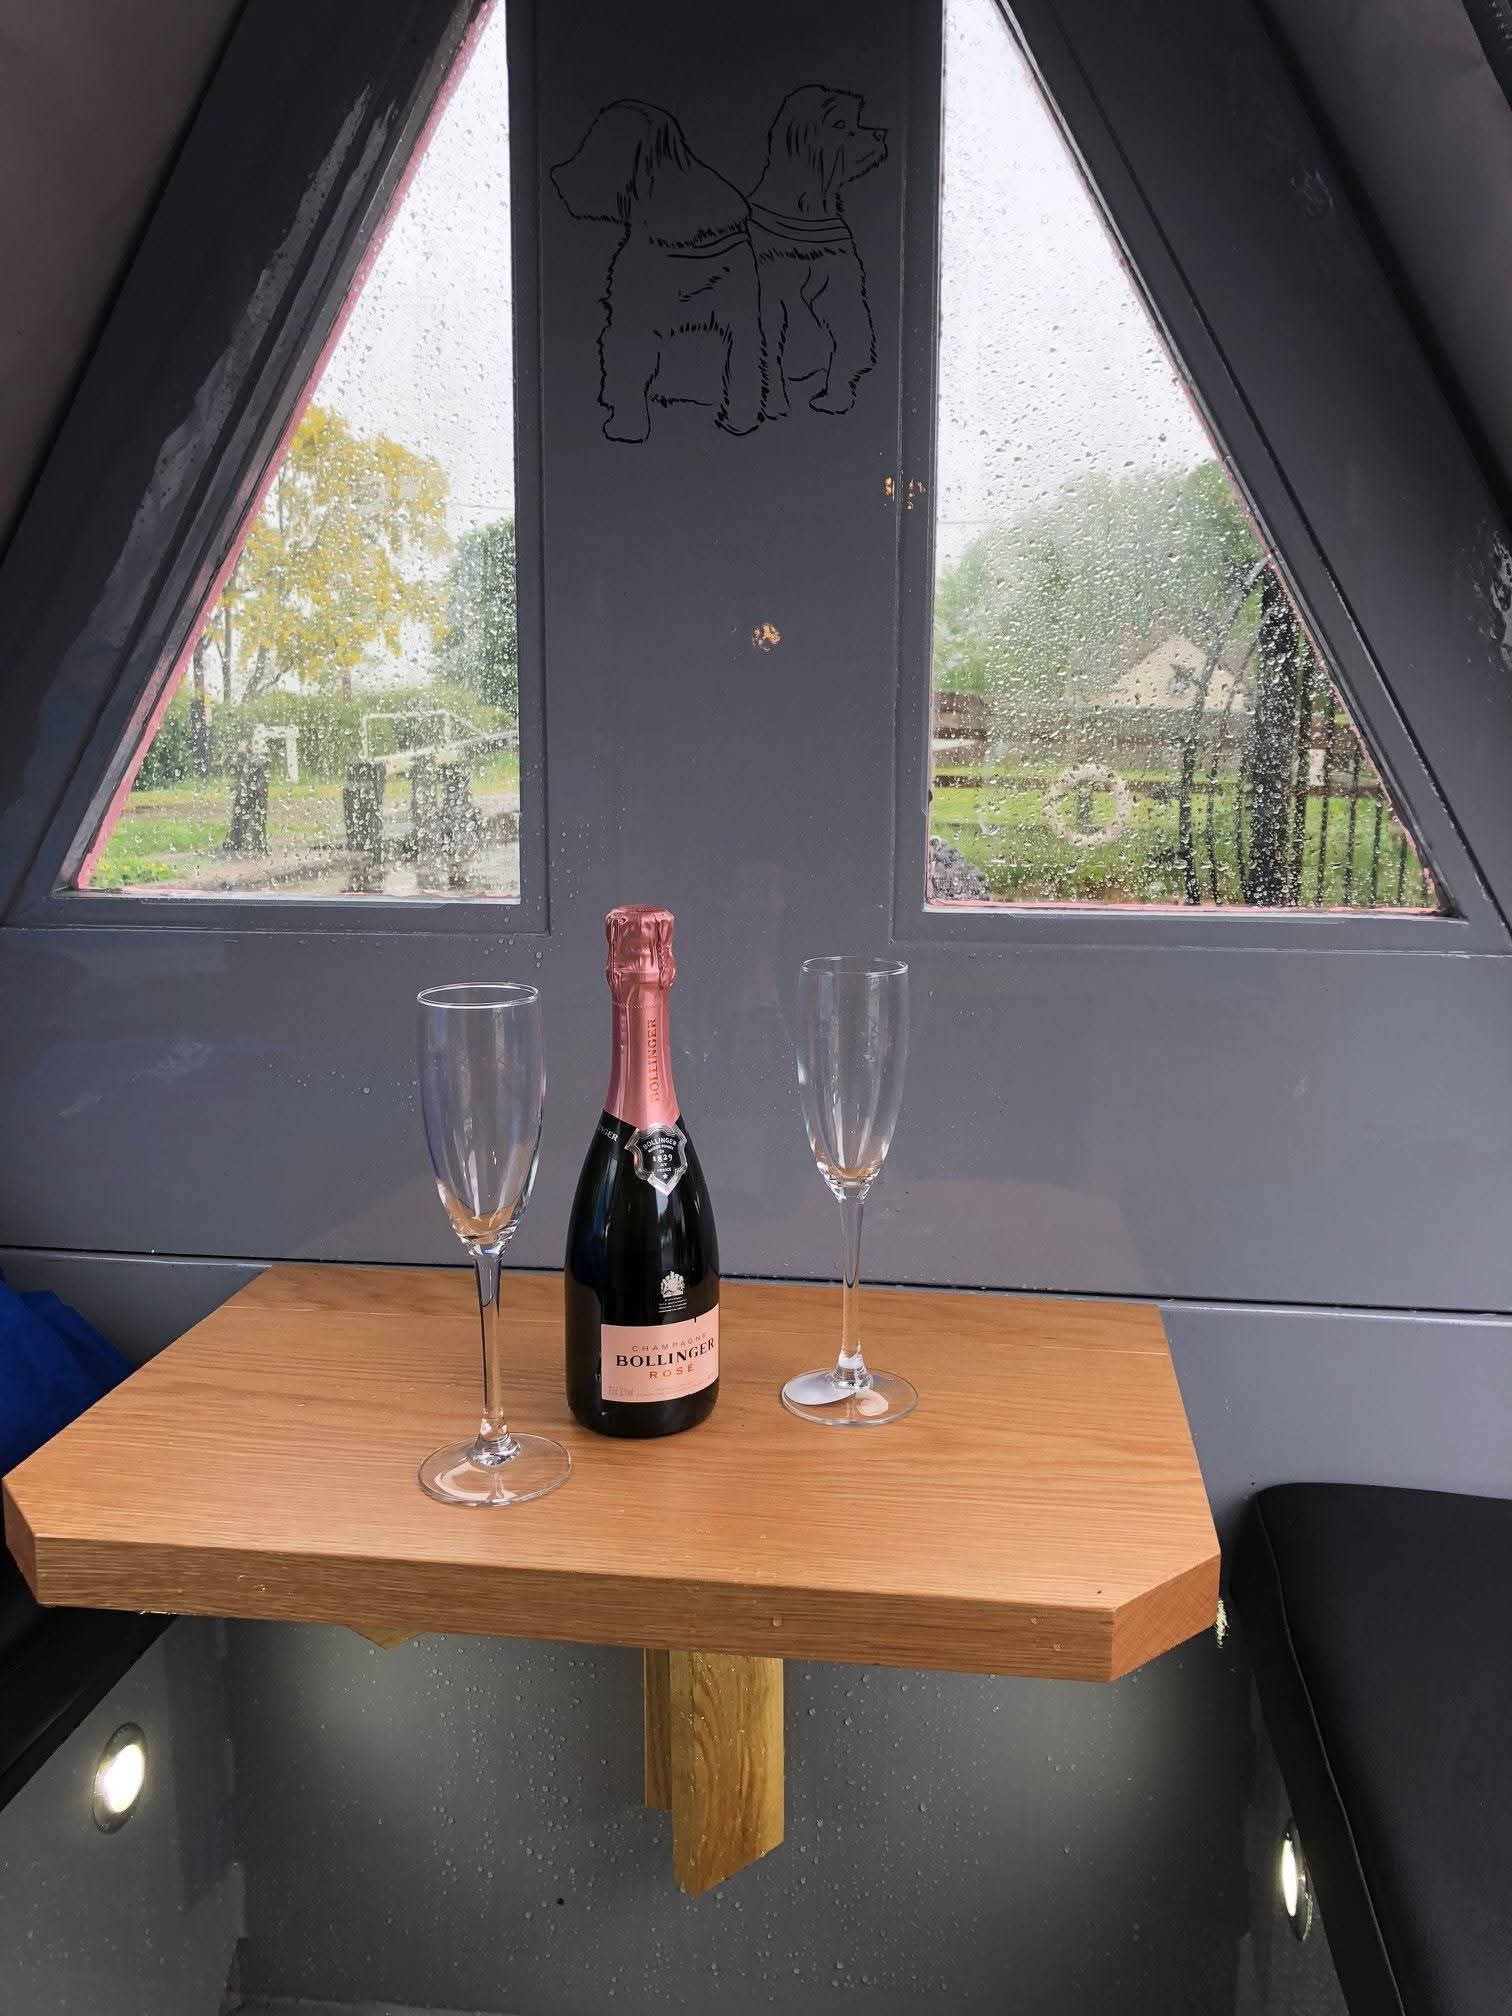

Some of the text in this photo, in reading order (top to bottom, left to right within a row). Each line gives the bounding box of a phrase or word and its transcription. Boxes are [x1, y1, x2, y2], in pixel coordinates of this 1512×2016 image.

[647, 1018, 660, 1103] BOLLINGER
[642, 1137, 678, 1150] BOLLINGER
[652, 1153, 673, 1163] 1829
[616, 1337, 715, 1367] BOLLINGER
[632, 1332, 707, 1352] CHAMPAGNE
